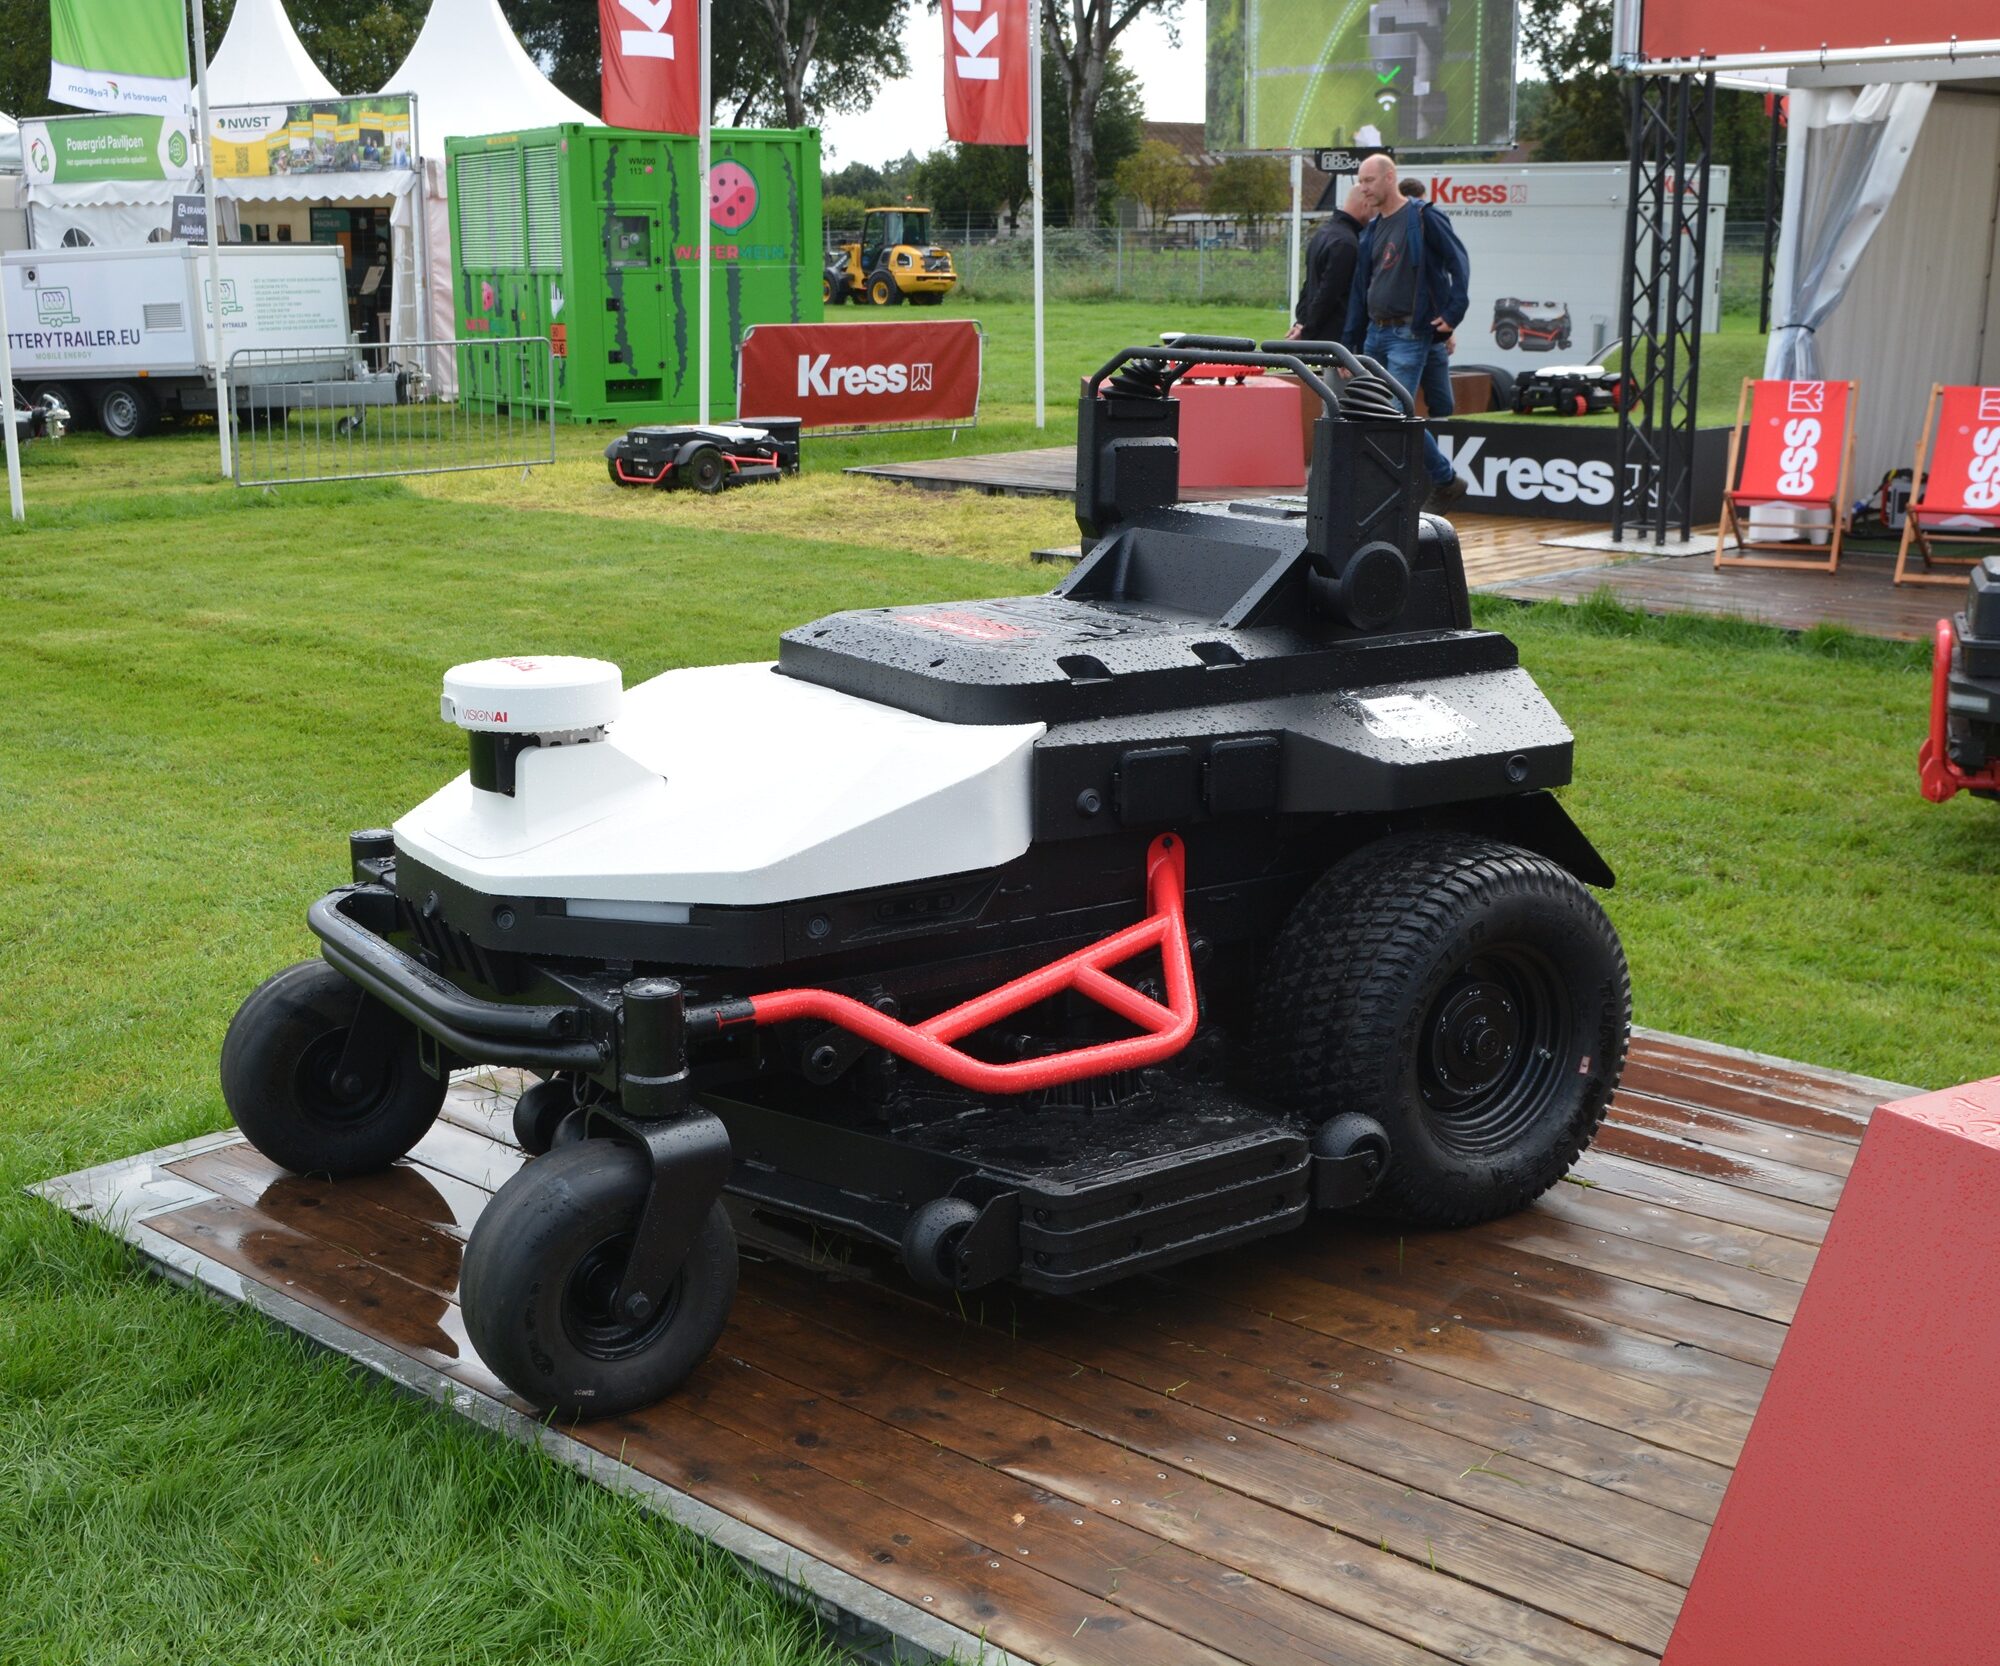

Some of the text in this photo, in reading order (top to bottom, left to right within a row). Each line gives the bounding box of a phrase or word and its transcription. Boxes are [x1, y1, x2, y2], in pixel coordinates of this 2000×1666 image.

[228, 116, 271, 129] NWST
[66, 135, 144, 153] Powergrid Paviljoen
[1431, 177, 1507, 204] Kress
[180, 225, 205, 236] Mobiele
[7, 328, 141, 350] TTERYTRAILER.EU
[35, 351, 93, 361] MOBILE ENERGY
[797, 353, 908, 397] Kress
[1776, 418, 1822, 496] ess
[1962, 425, 2000, 509] ess
[1437, 434, 1615, 506] Kress
